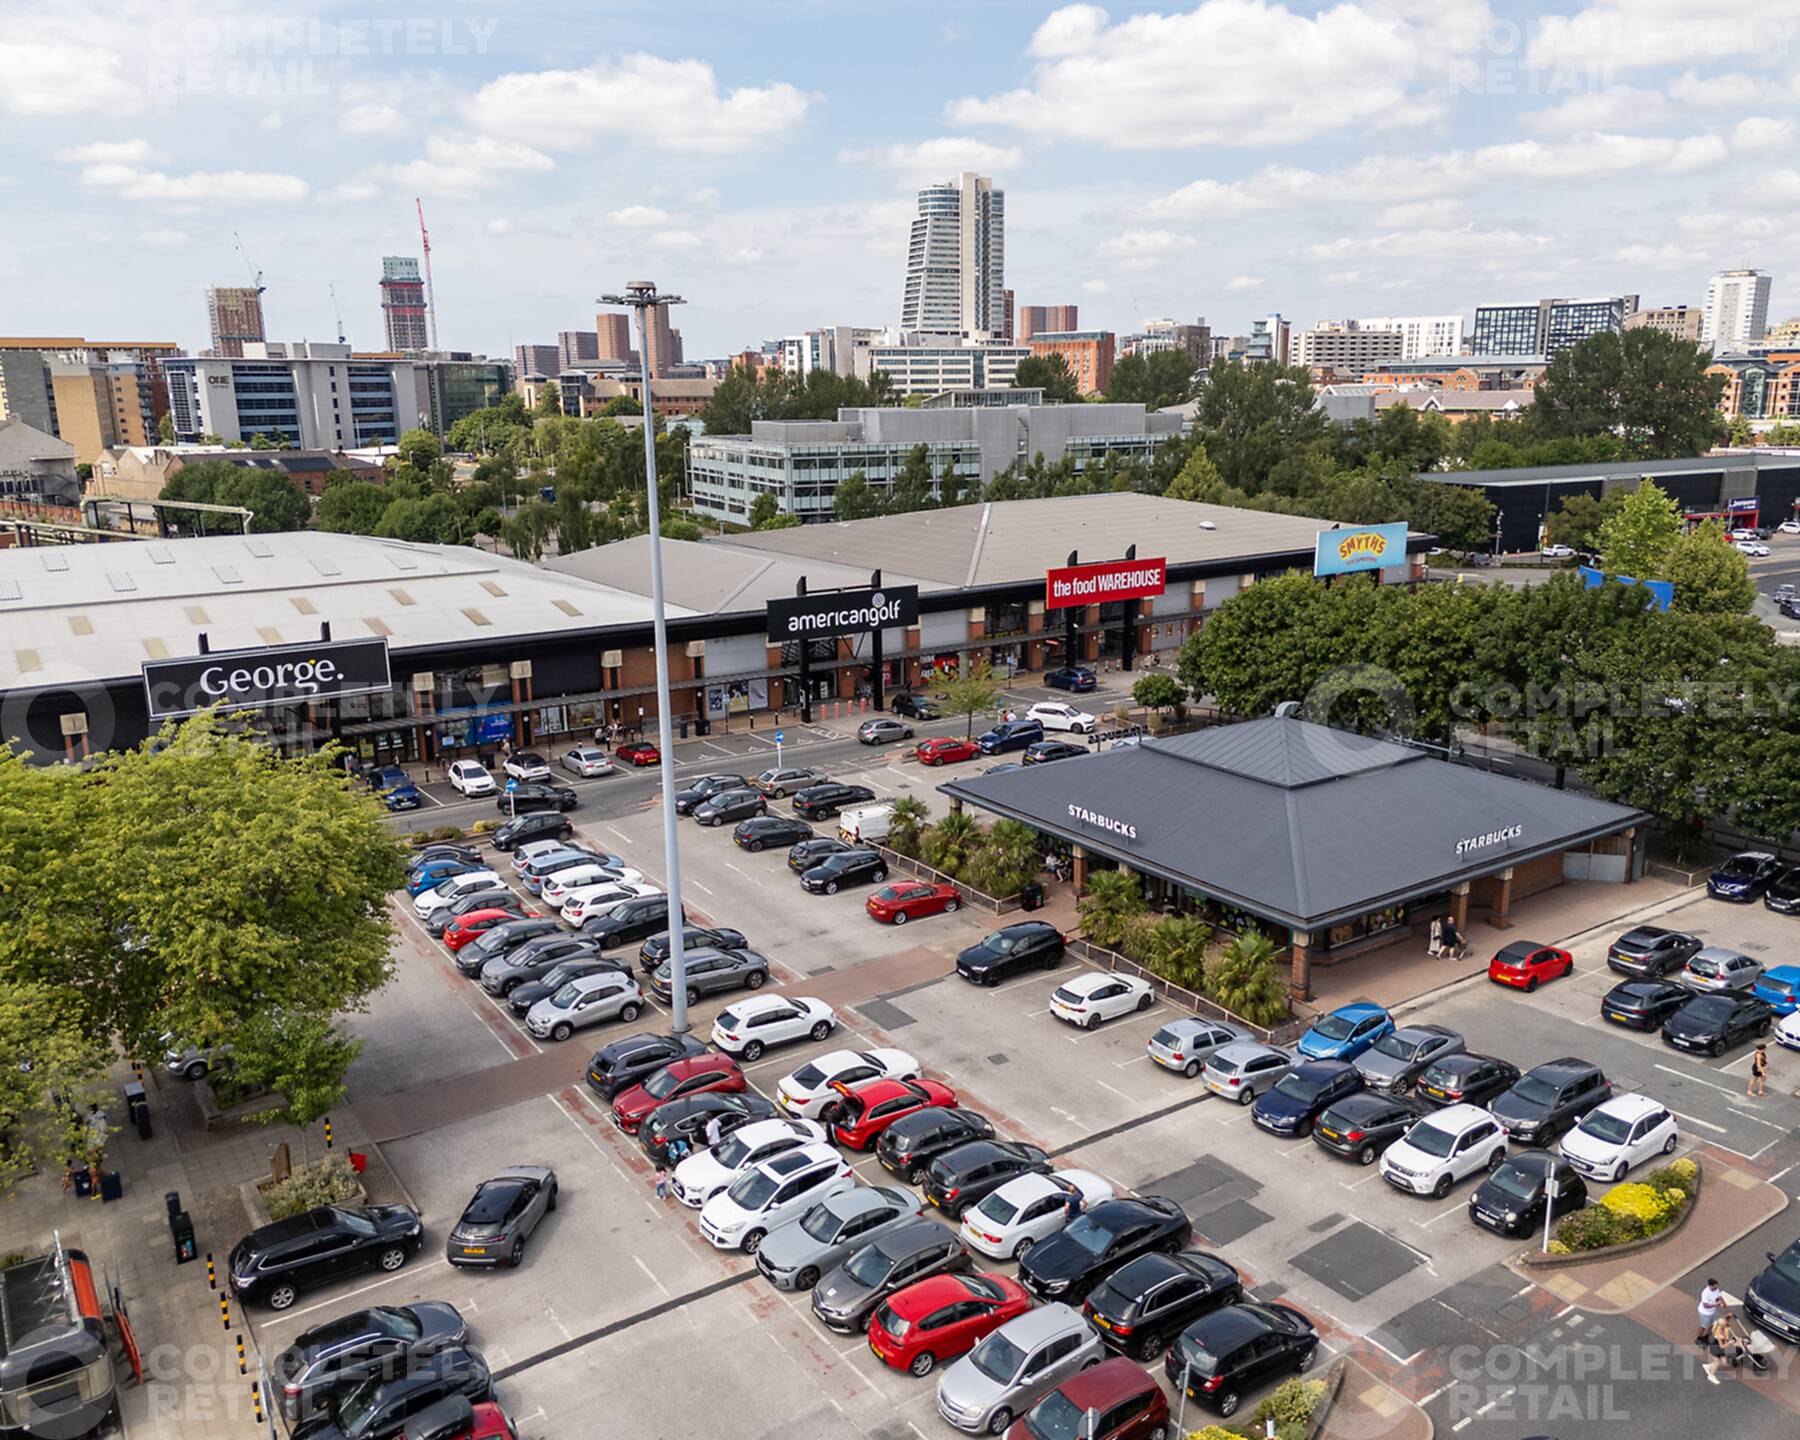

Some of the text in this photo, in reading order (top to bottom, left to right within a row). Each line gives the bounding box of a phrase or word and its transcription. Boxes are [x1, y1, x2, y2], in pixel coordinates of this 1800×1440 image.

[1339, 533, 1386, 559] SMYTHS
[1053, 568, 1161, 597] the food WAREHOUSE
[788, 599, 901, 632] americangolf
[1068, 804, 1136, 838] STARBUCKS
[1456, 824, 1522, 854] STARBUCKS
